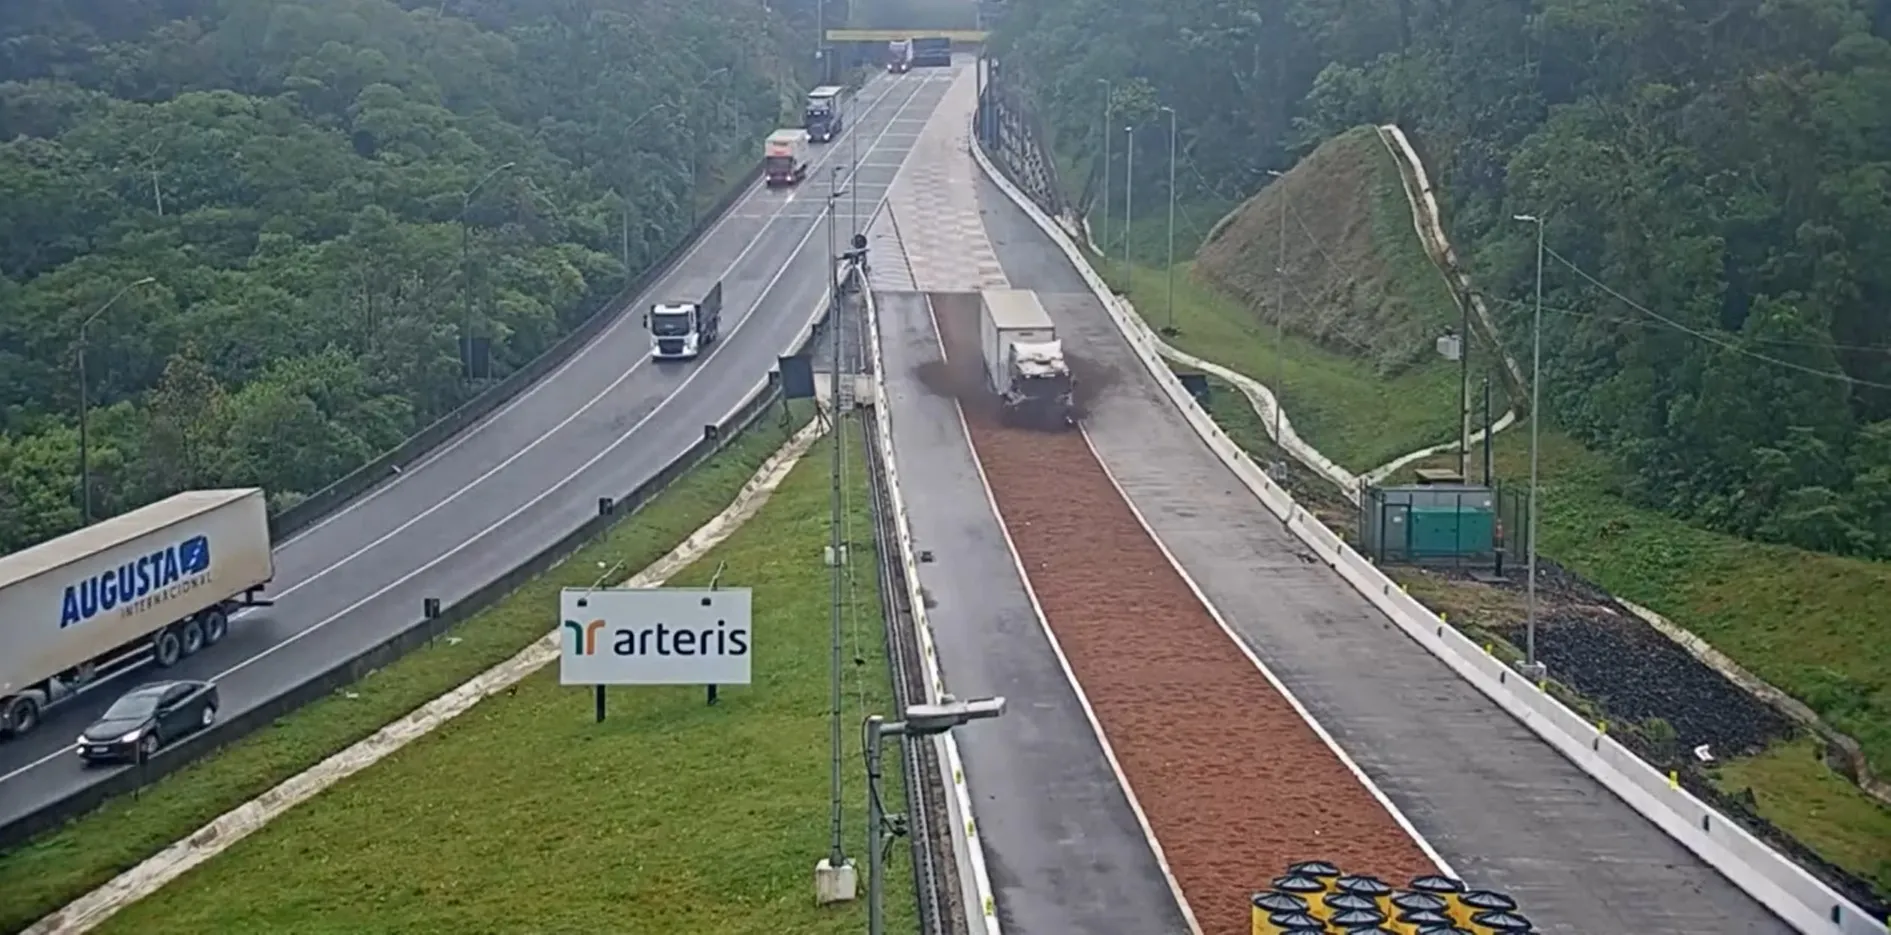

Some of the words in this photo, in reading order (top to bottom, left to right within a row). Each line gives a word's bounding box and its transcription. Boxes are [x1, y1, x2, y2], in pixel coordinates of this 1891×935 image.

[60, 547, 178, 628] AUGUSTA
[121, 574, 213, 618] INTERNACIONAL
[614, 620, 748, 656] arteris
